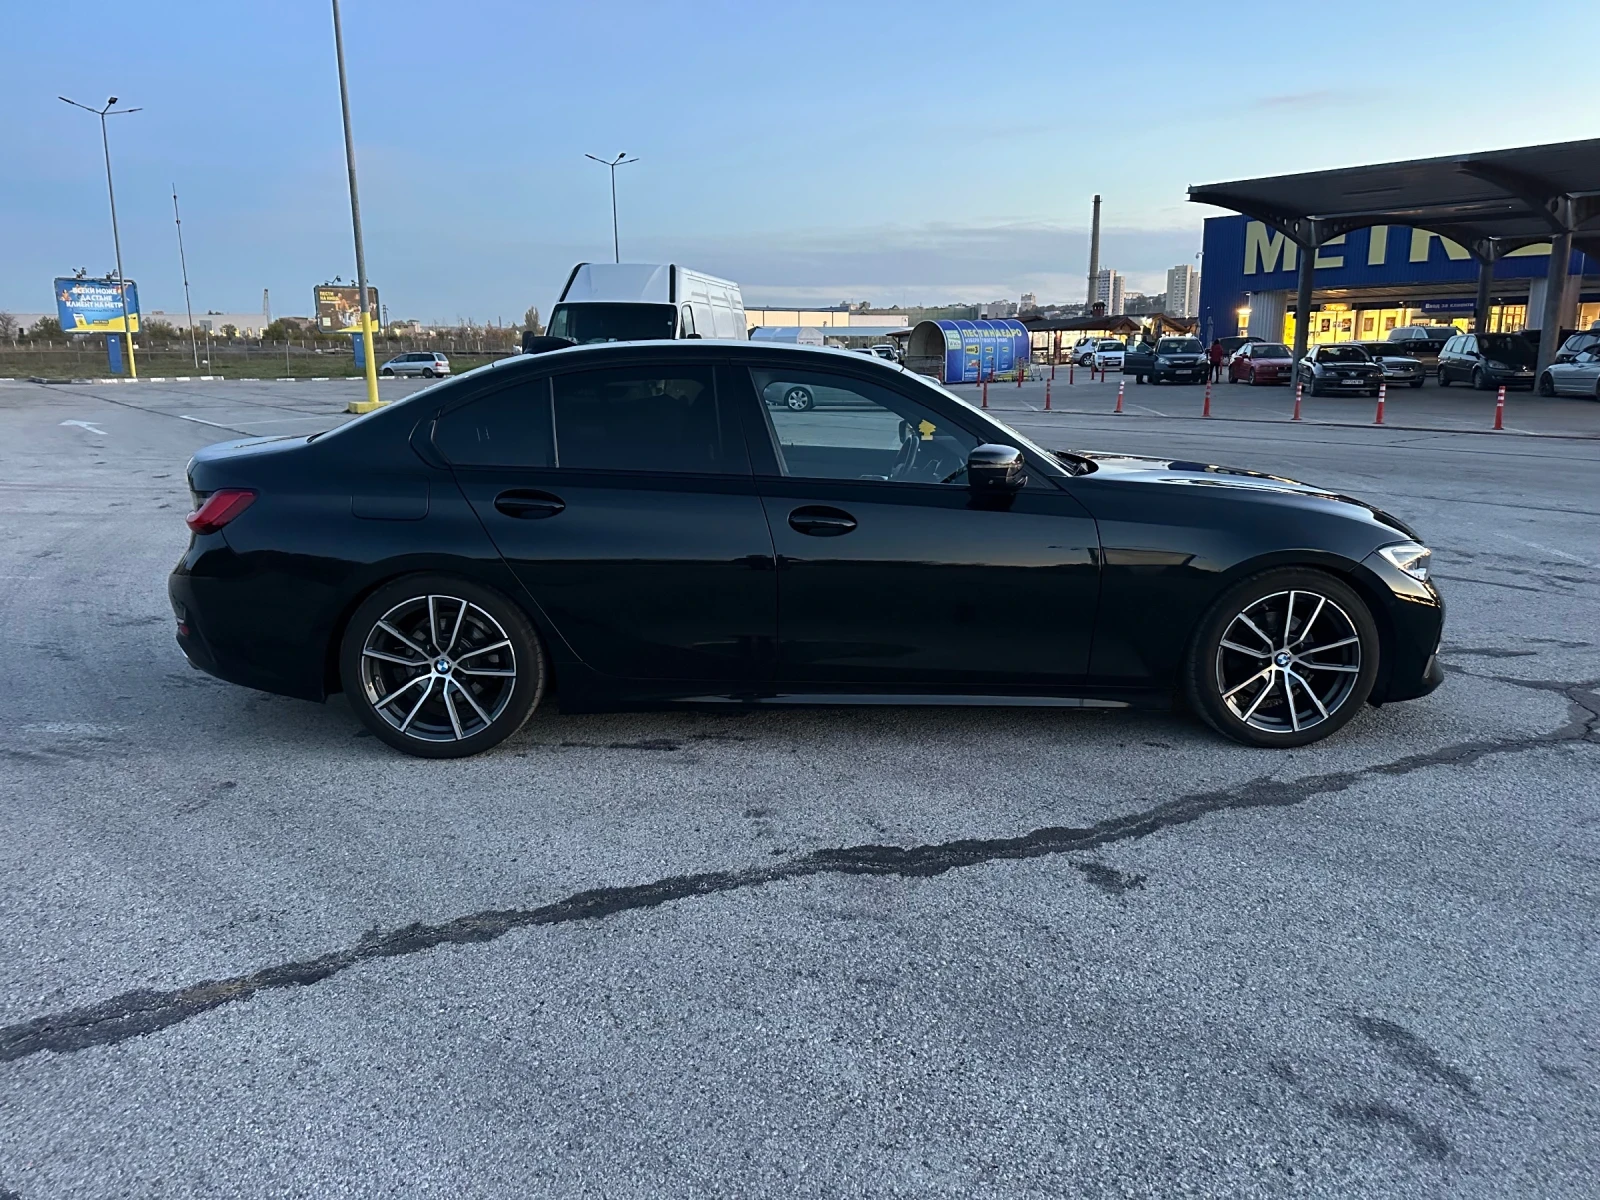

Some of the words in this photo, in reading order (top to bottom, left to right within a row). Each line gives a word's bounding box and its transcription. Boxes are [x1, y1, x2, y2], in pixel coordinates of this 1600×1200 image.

[1244, 220, 1552, 274] METR
[962, 329, 989, 338] ПЕСТИ
[989, 329, 1001, 338] НА
[1001, 328, 1022, 338] ЕДРО
